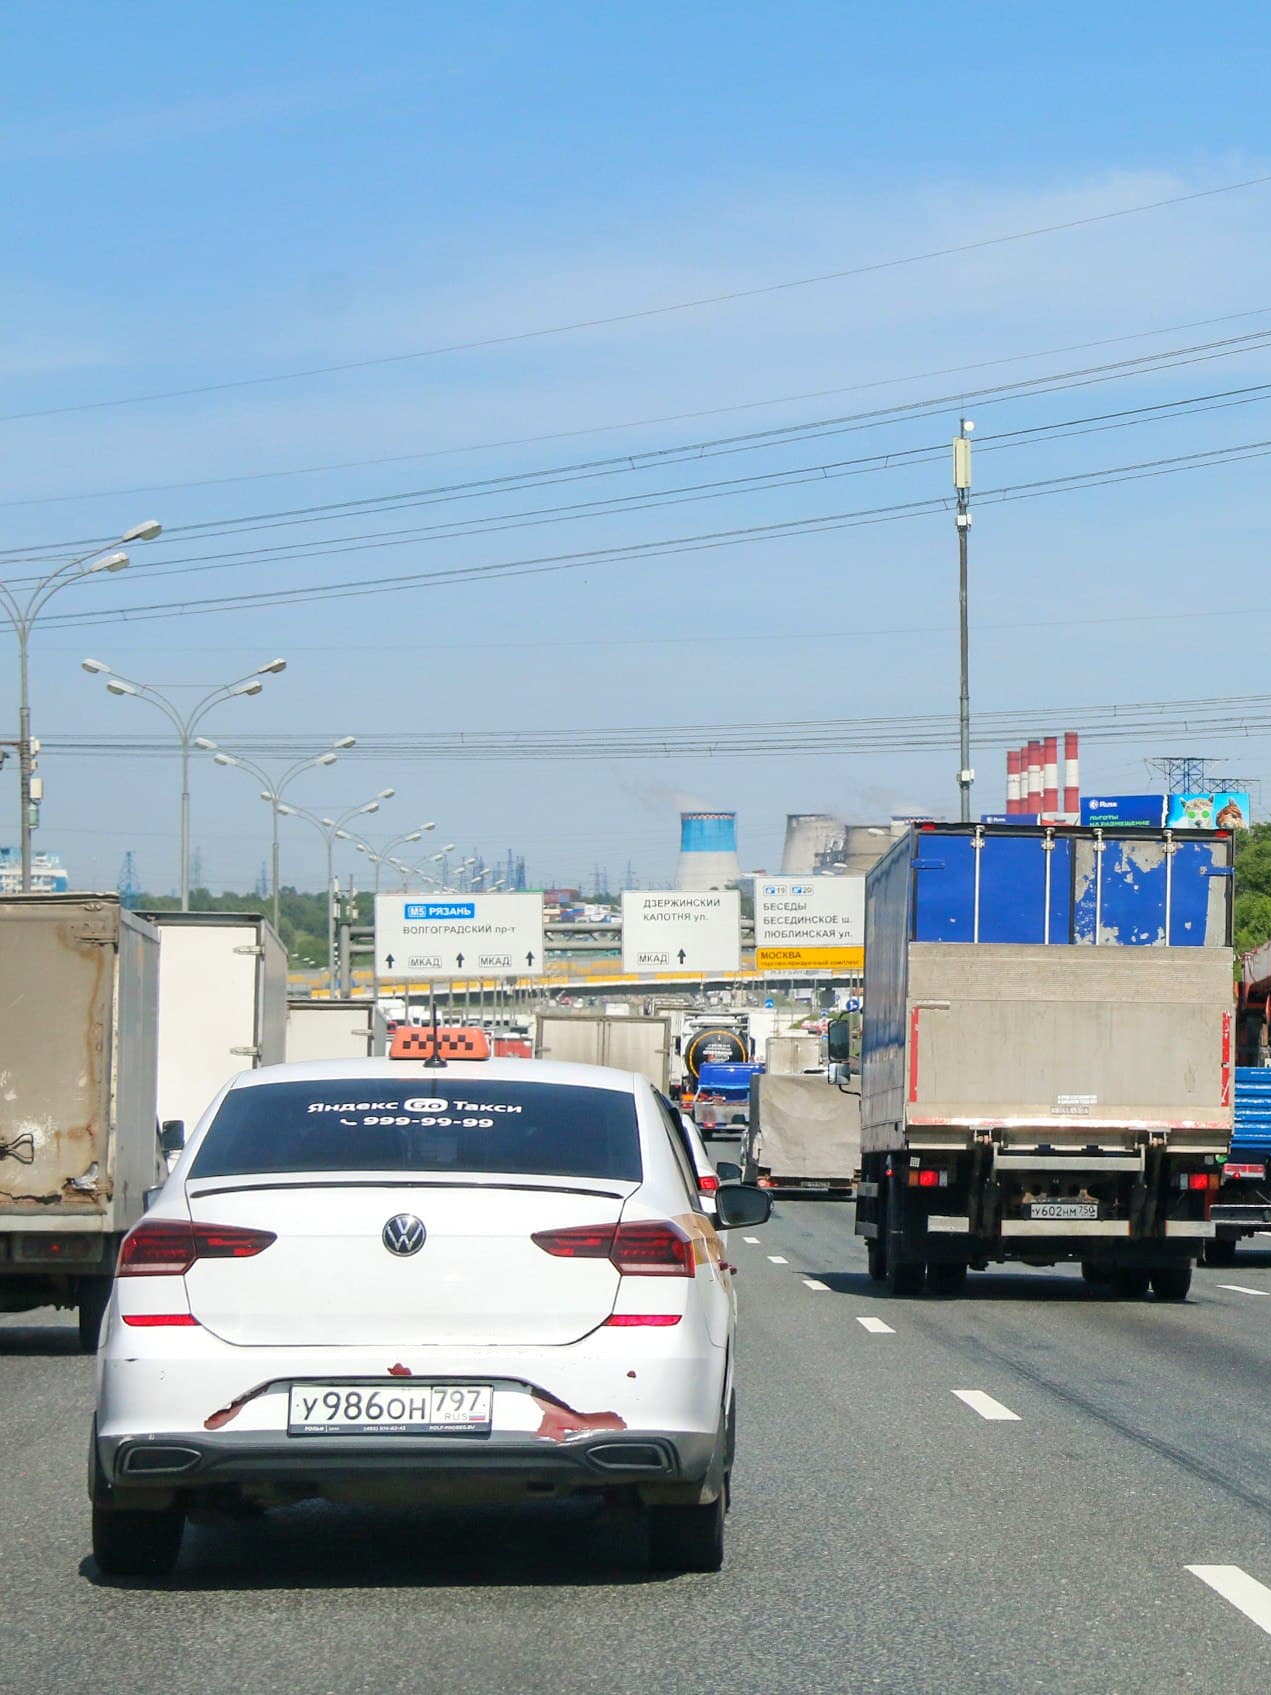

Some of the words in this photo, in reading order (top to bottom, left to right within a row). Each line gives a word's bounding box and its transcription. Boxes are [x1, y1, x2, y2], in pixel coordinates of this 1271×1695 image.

[429, 907, 472, 916] РЯЗАНЬ
[763, 902, 807, 912] БЕСЕДЫ
[643, 912, 691, 921] КАПОТНЯ
[763, 915, 838, 925] БЕСЕДИНСКОЕ
[403, 925, 492, 935] ВОЛГОГРАДСКИЙ
[495, 926, 516, 936] пр-т
[764, 929, 836, 939] ЛЮБЛИНСКАЯ
[639, 954, 668, 963] МКАД
[760, 951, 801, 960] МОСКВА
[410, 958, 440, 967] МКАД
[480, 957, 510, 966] МКАД
[307, 1101, 399, 1113] Яндекс
[453, 1101, 523, 1113] Такси
[363, 1116, 494, 1128] 999-99-99
[303, 1391, 426, 1421] У986ОН
[434, 1390, 481, 1412] 797
[444, 1412, 468, 1421] RUS
